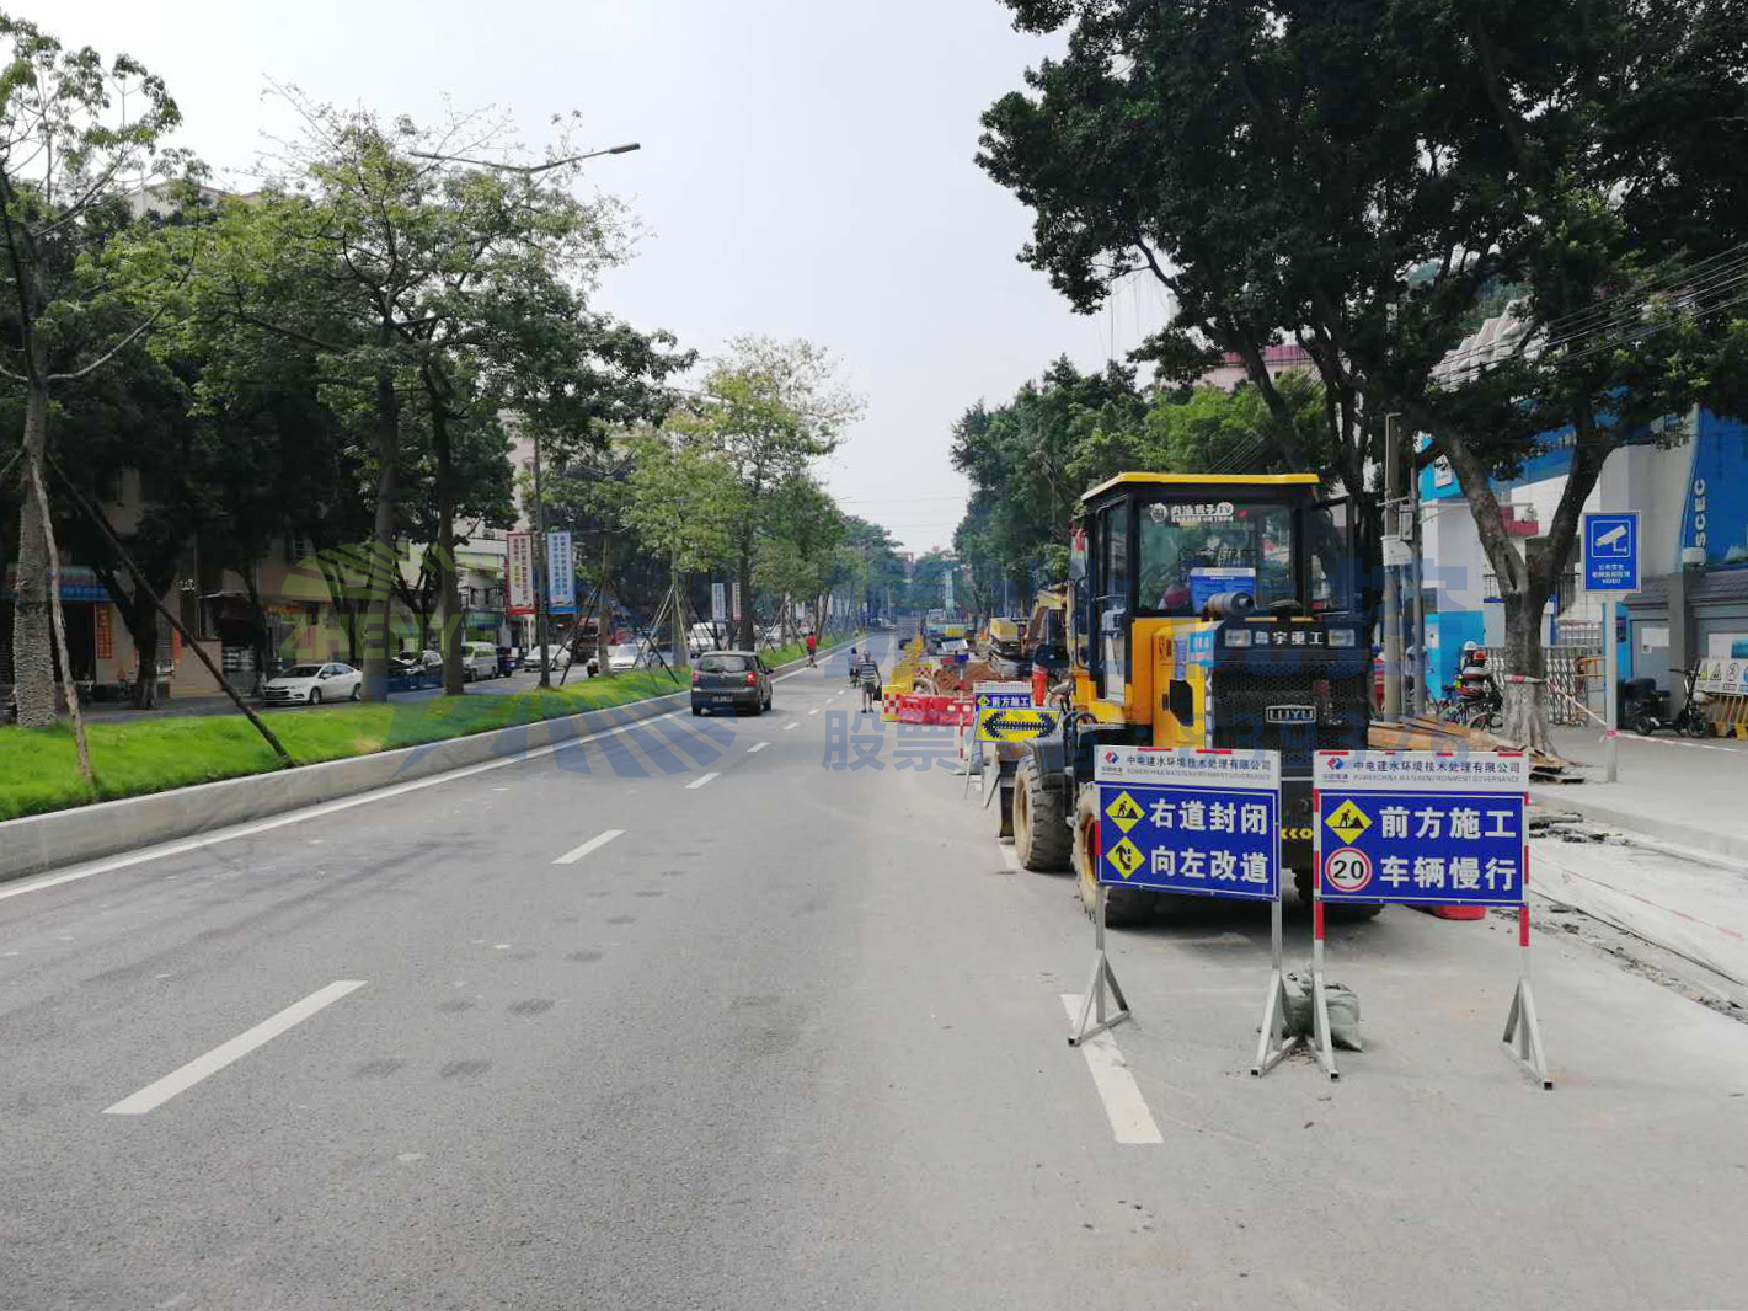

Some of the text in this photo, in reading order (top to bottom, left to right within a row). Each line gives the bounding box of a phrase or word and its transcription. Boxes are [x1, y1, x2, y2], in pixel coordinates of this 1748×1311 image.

[1353, 760, 1520, 774] 中电建水环境技术处理有限公司
[1149, 798, 1268, 836] 右道封闭
[1379, 806, 1517, 840] 前方施工
[1150, 846, 1269, 884] 向左改道
[1332, 859, 1365, 880] 20
[1379, 855, 1517, 890] 车辆慢行
